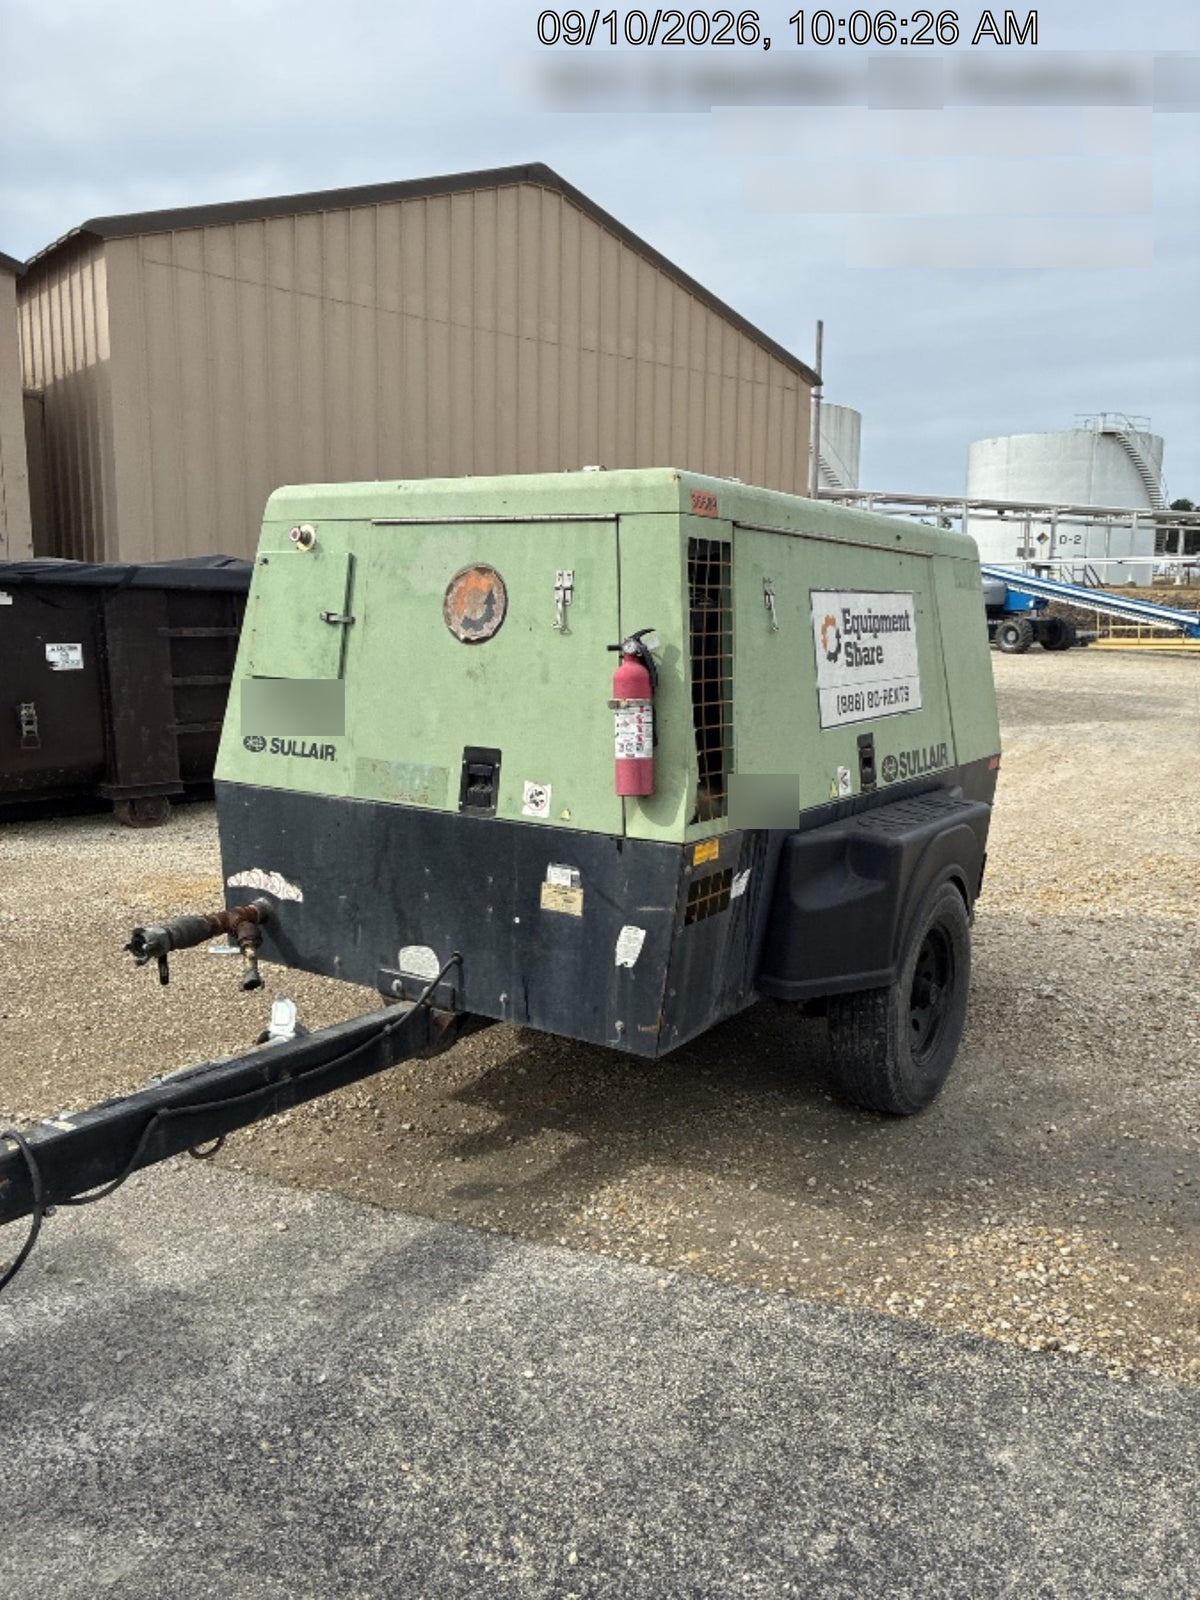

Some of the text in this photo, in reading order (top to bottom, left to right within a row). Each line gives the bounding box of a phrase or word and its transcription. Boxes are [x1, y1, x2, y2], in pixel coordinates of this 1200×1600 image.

[841, 607, 911, 640] Equipment
[844, 641, 884, 667] Share
[837, 691, 865, 716] (888)
[269, 737, 337, 762] SULLAIR
[899, 742, 949, 779] SULLAIR
